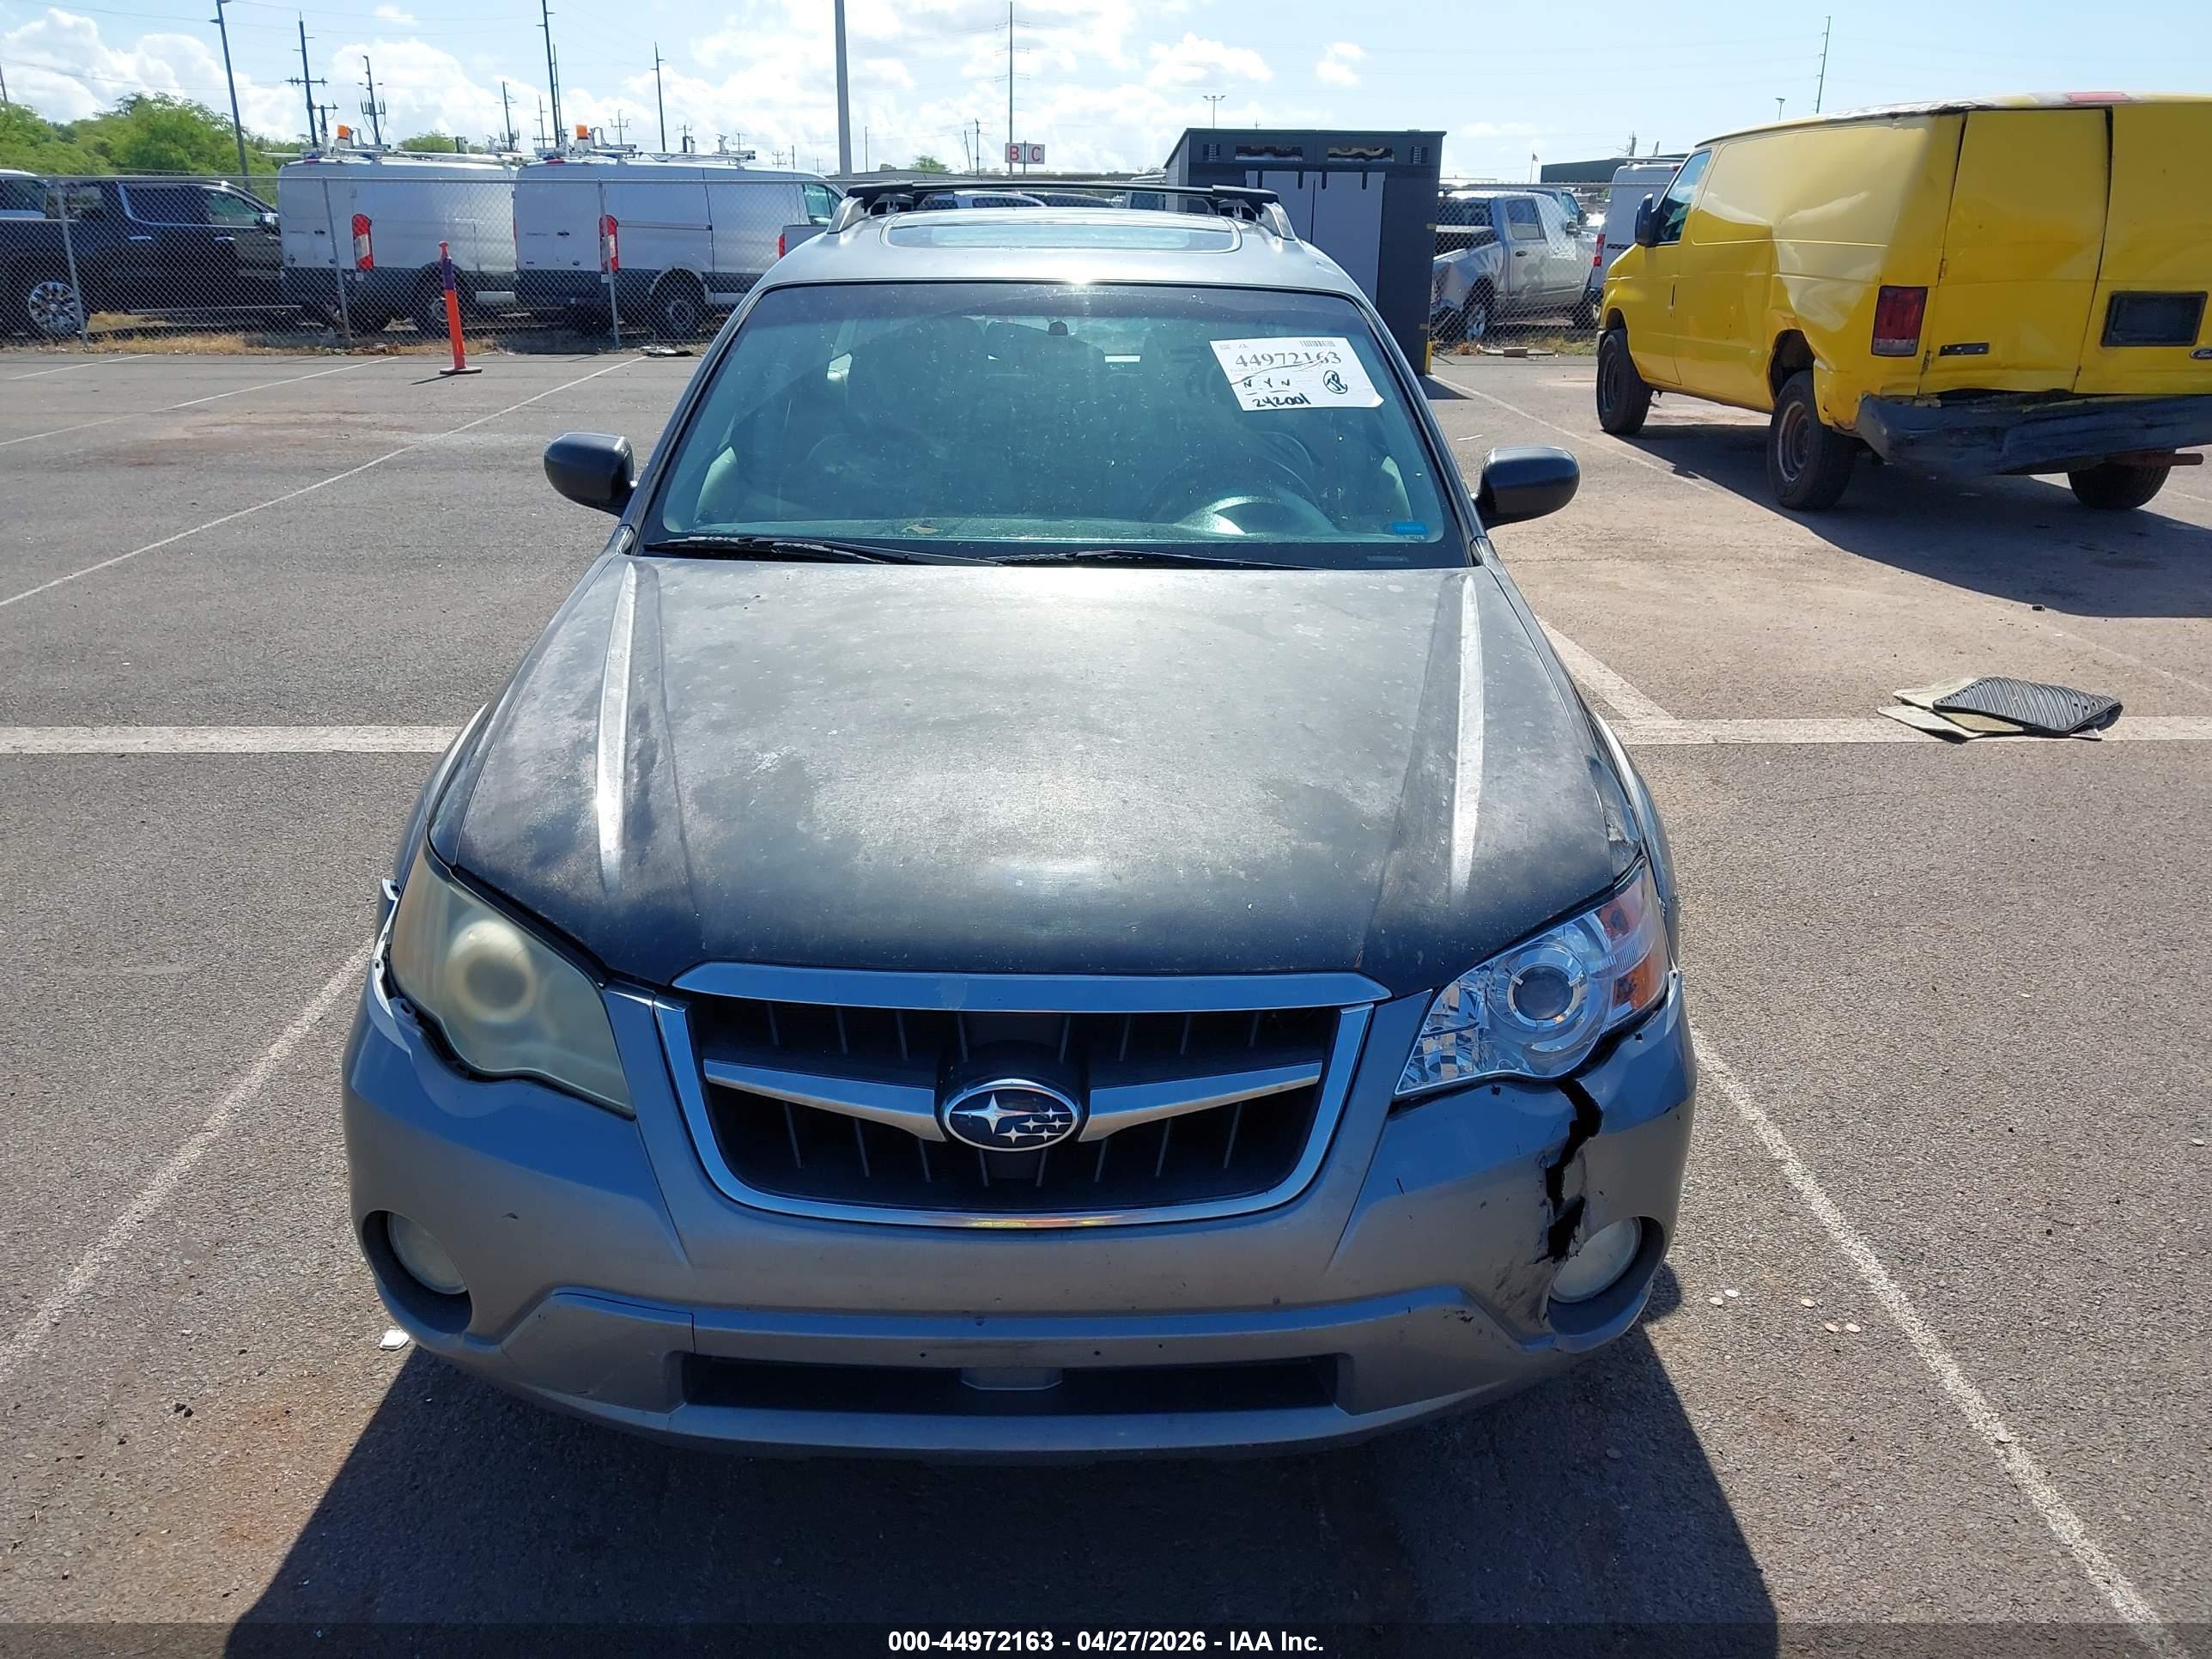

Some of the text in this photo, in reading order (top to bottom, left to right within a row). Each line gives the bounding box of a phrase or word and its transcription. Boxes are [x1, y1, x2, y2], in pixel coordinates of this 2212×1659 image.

[1009, 146, 1019, 161] B
[1031, 146, 1041, 161] C
[1235, 351, 1341, 368] 44972163
